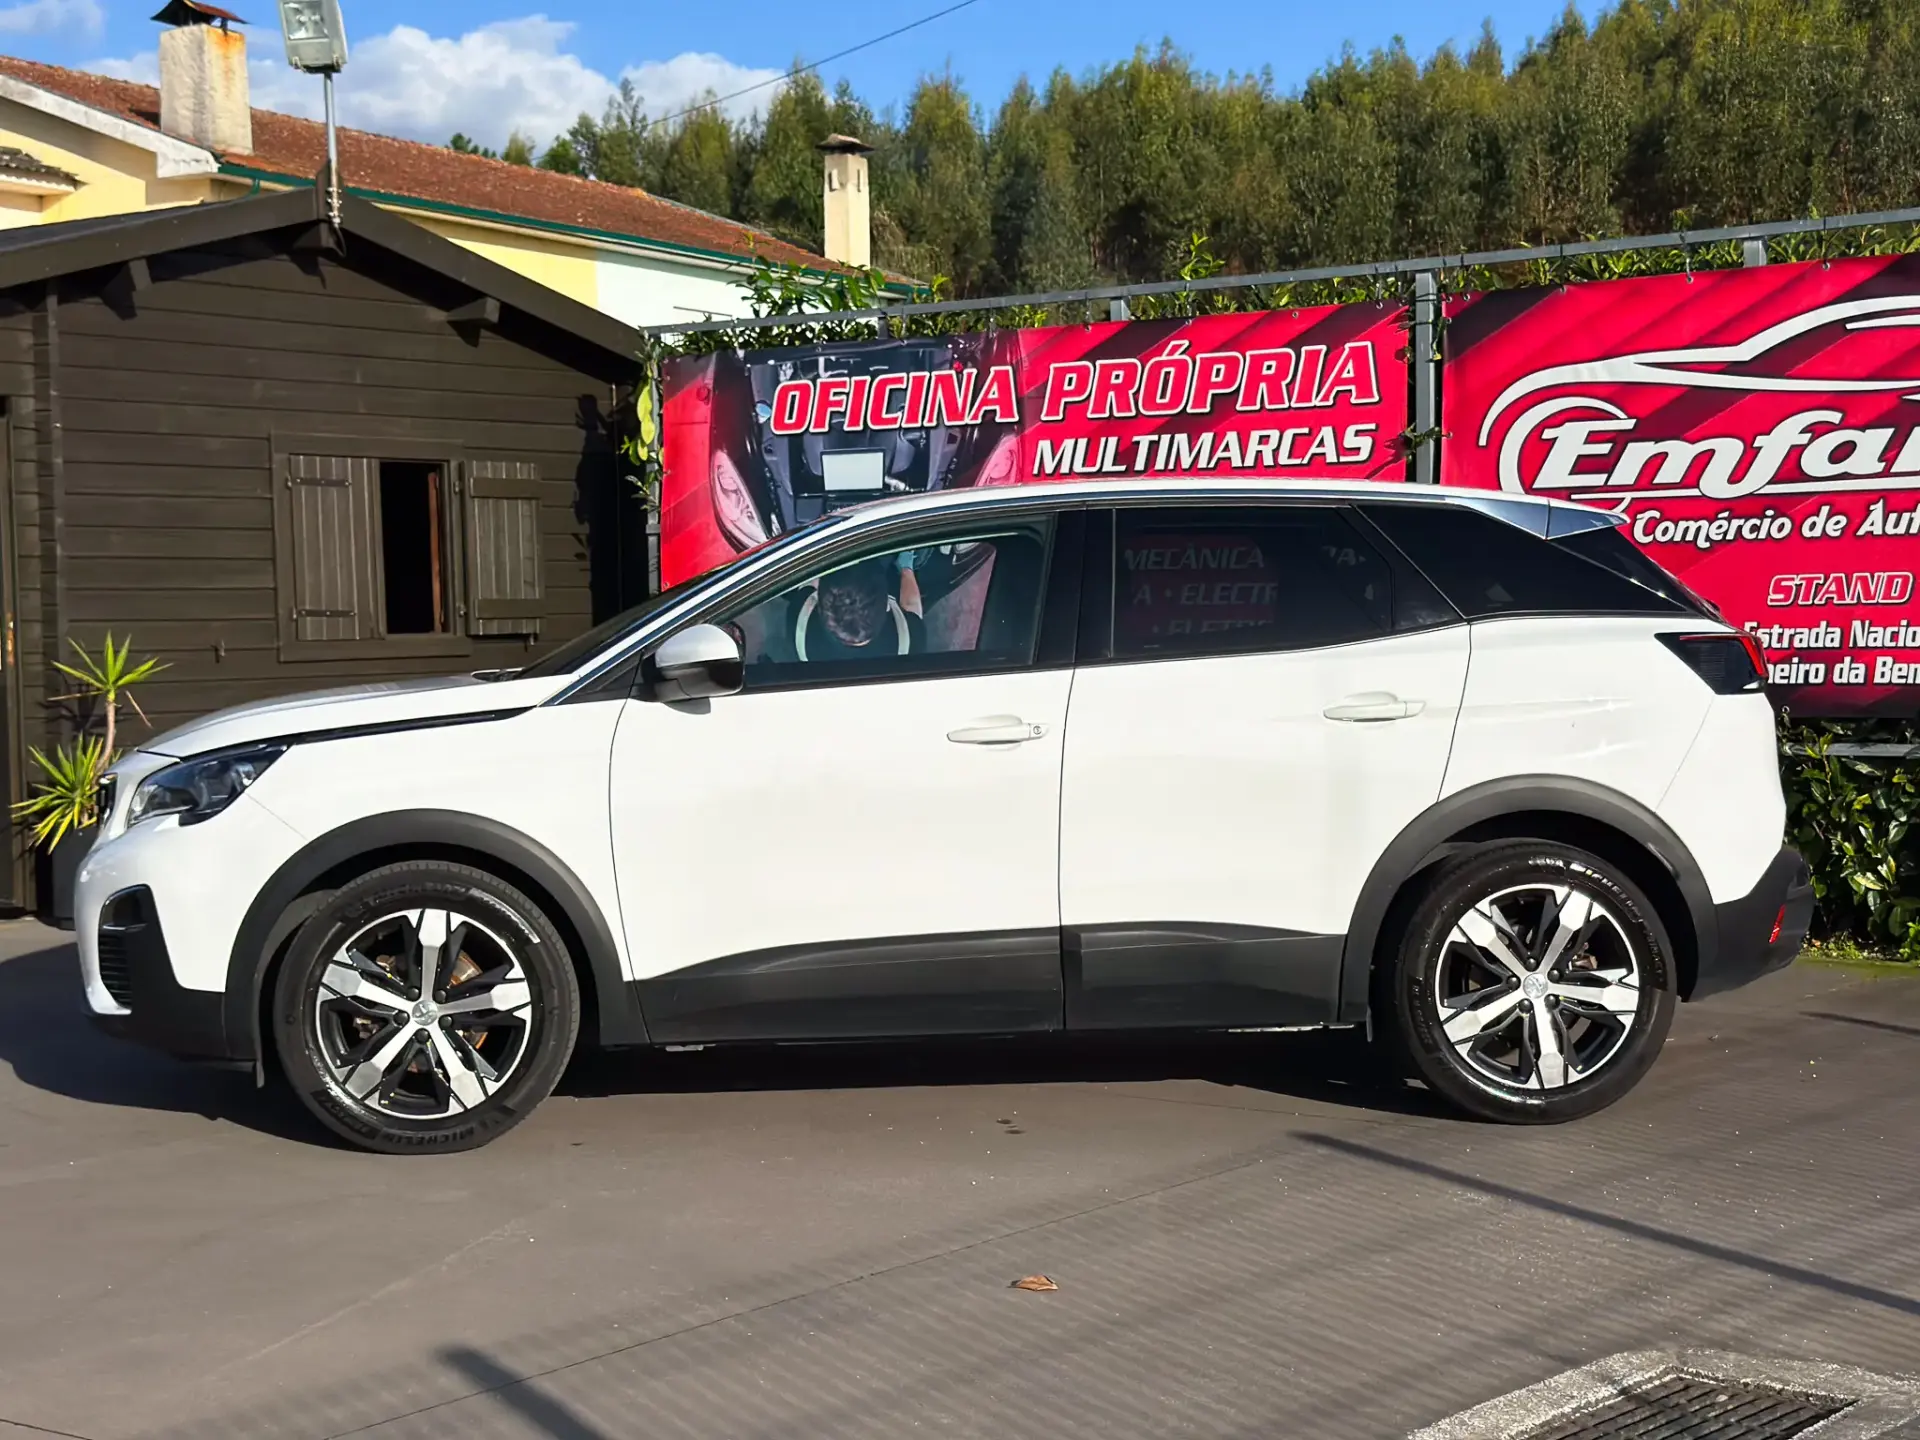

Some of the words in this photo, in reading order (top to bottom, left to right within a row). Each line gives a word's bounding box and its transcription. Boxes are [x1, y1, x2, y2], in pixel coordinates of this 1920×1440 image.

[771, 366, 1020, 435] OFICINA
[1040, 339, 1383, 423] PRÓPRIA
[1032, 421, 1378, 476] MULTIMARCAS
[1633, 510, 1793, 549] Comércio
[1801, 505, 1848, 538] de
[1766, 571, 1914, 606] STAND
[1848, 619, 1920, 648] Nacio
[1833, 655, 1866, 684] da
